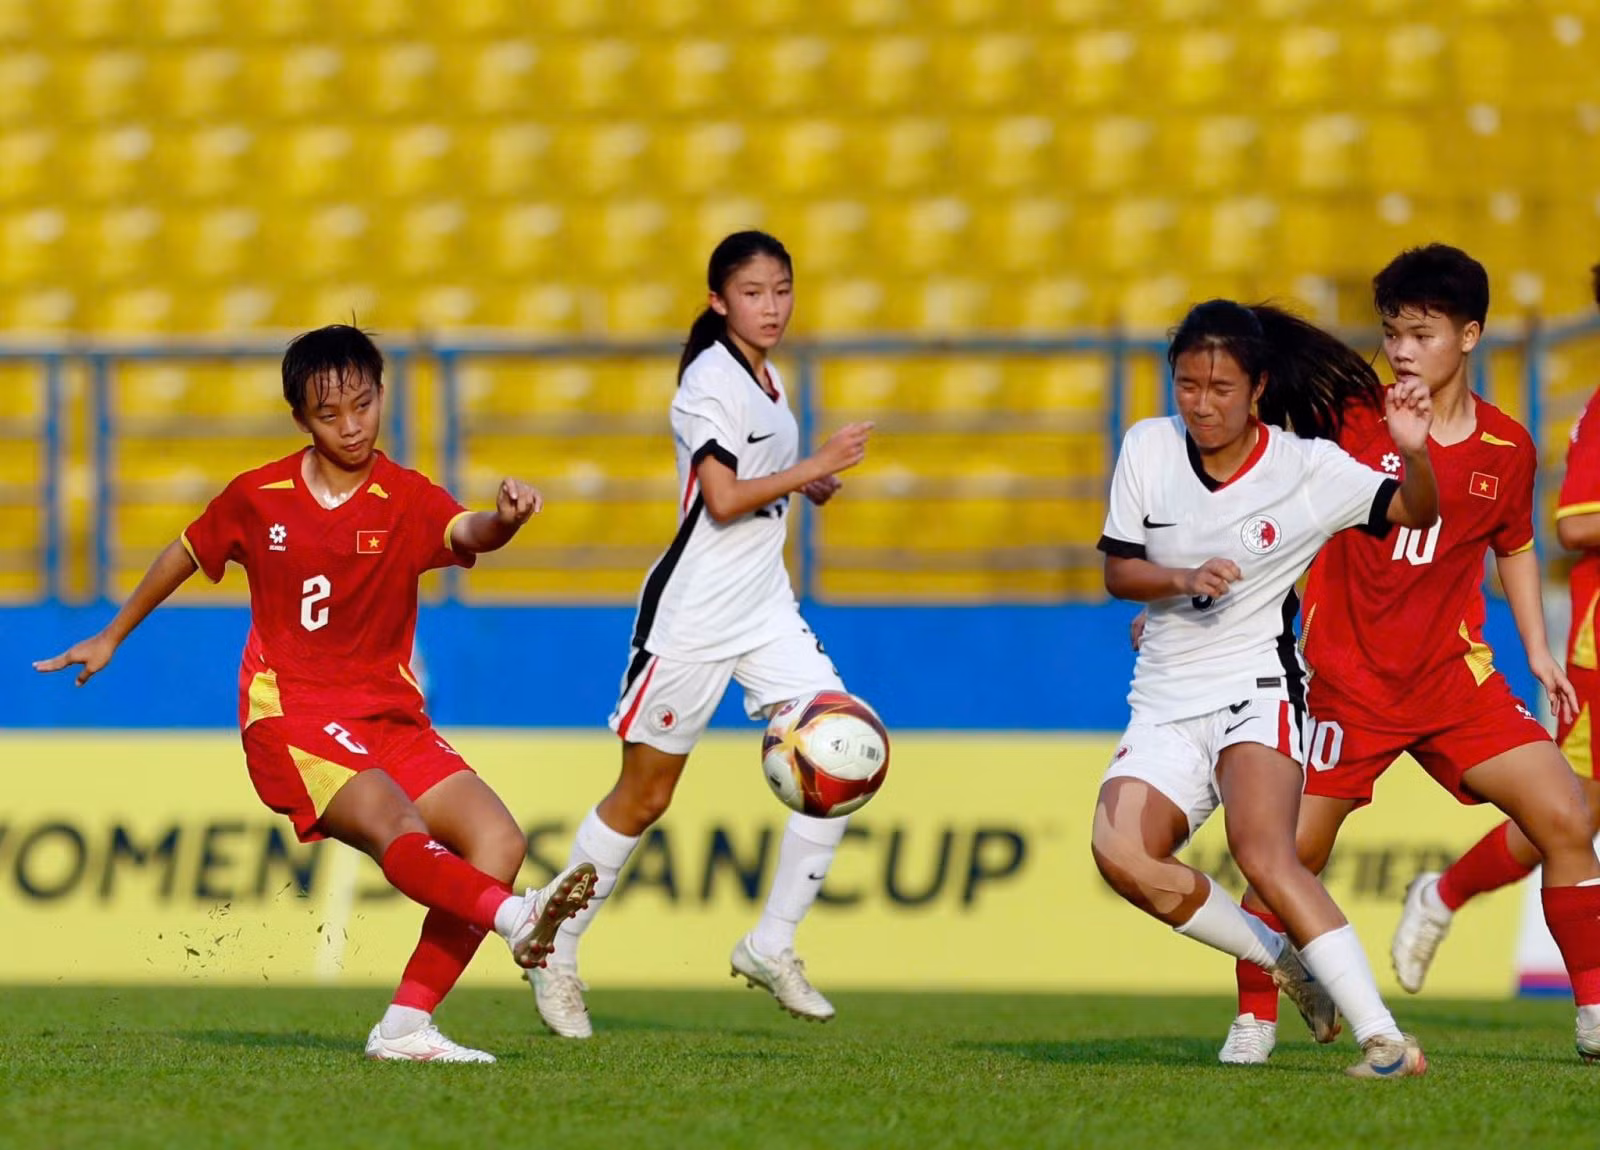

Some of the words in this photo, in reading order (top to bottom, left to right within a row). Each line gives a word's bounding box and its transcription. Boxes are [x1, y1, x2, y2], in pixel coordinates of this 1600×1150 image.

[1391, 516, 1443, 566] 10
[301, 574, 331, 632] 2
[323, 721, 368, 755] 2
[0, 821, 402, 901] OMEN
[518, 822, 773, 904] SAN
